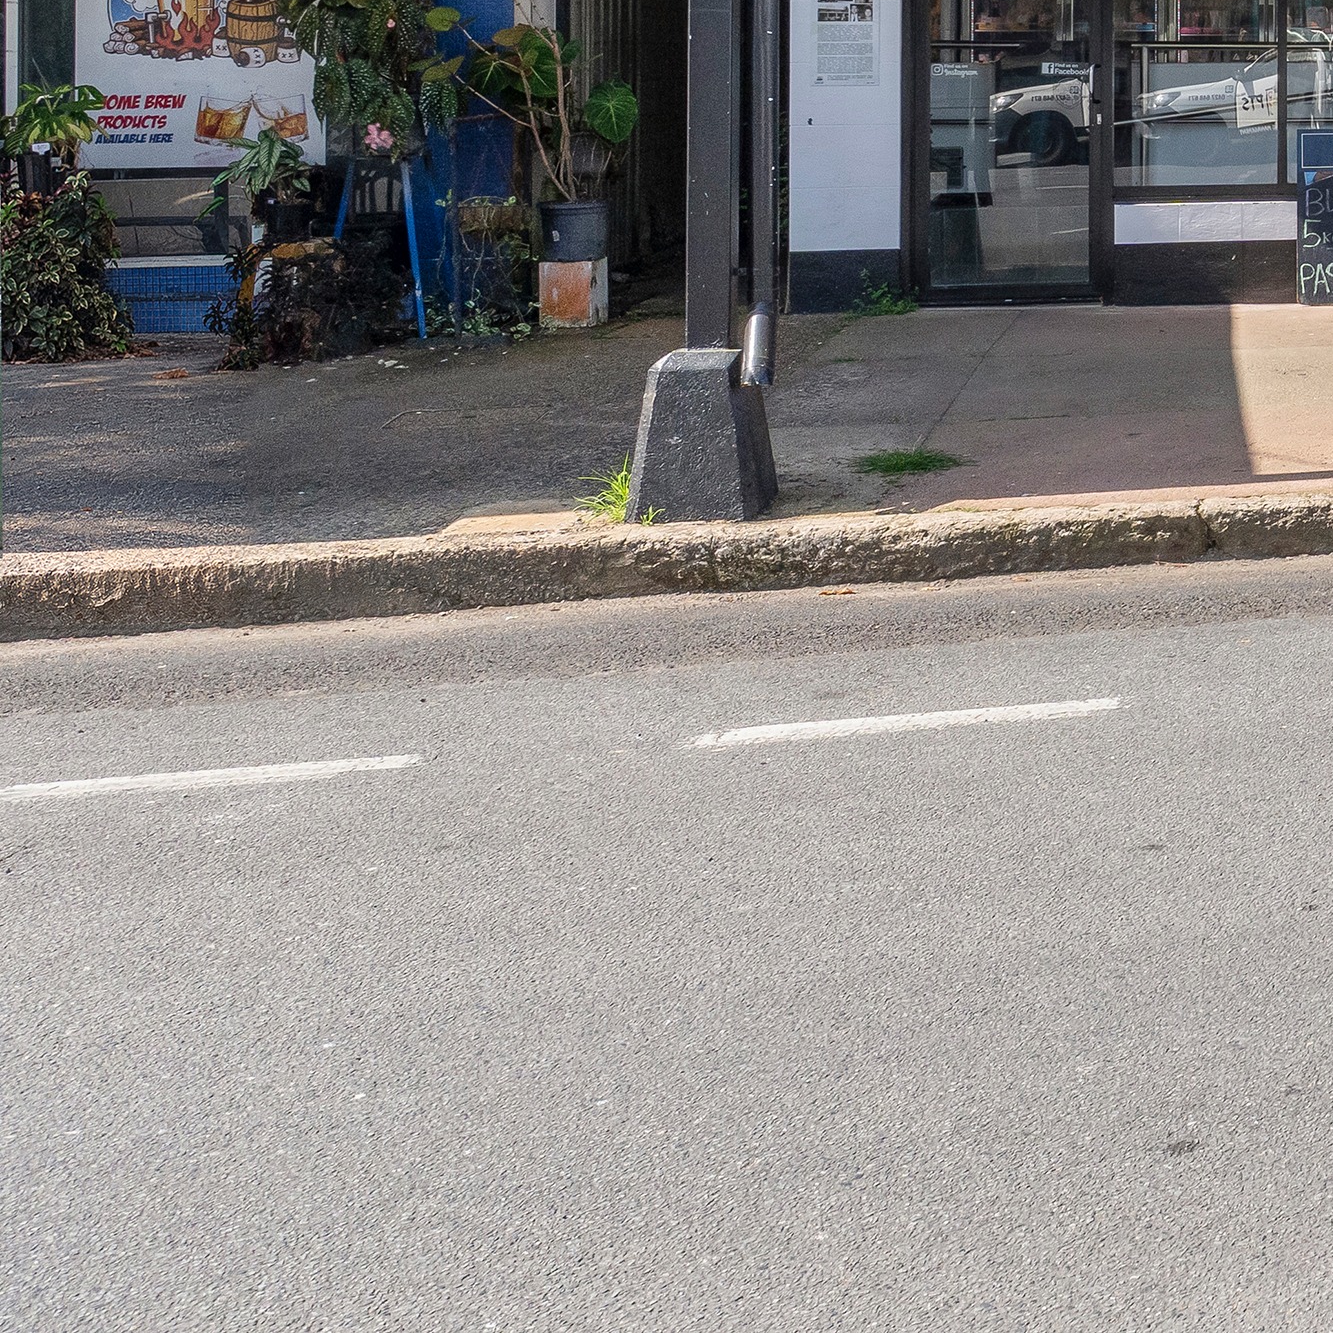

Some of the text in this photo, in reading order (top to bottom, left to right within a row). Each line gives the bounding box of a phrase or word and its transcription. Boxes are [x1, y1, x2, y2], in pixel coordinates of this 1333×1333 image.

[944, 69, 978, 78] Instagram
[144, 94, 187, 110] BREW
[97, 115, 167, 129] PRODUCTS
[95, 133, 174, 144] AVAILABLE HERE
